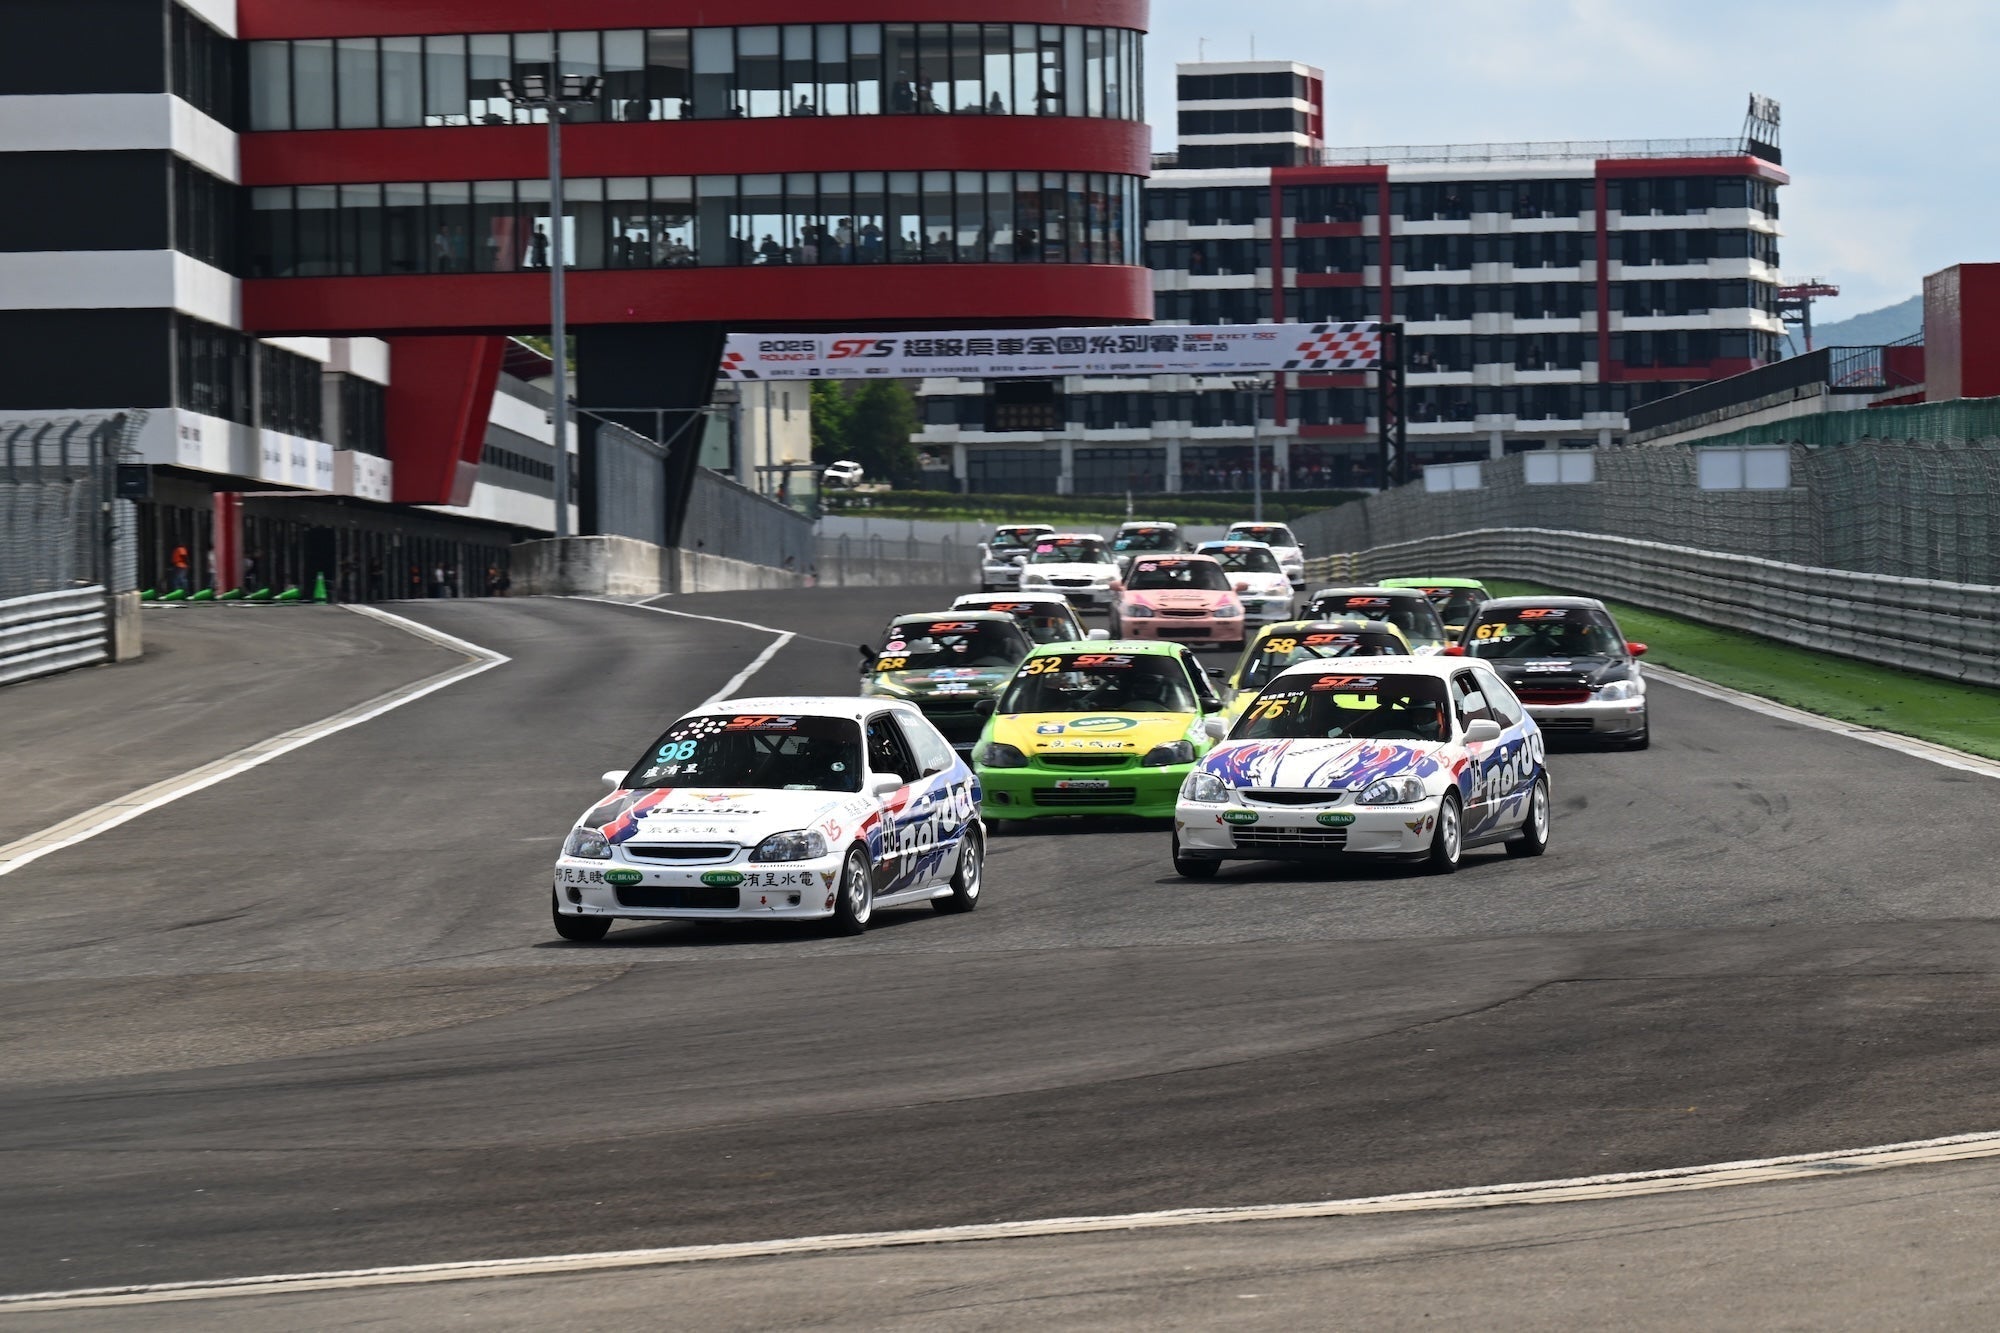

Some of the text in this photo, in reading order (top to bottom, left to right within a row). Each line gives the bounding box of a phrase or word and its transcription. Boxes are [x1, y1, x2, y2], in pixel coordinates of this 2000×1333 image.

[759, 340, 815, 351] 2025
[826, 339, 898, 359] STS
[1518, 609, 1570, 619] STS
[929, 622, 979, 632] STS
[1476, 623, 1508, 639] 67
[1263, 638, 1298, 654] 58
[1304, 634, 1360, 645] STS
[1027, 657, 1062, 674] 52
[1072, 654, 1134, 665] STS
[1312, 676, 1383, 687] STS
[1248, 700, 1289, 719] 75
[727, 716, 802, 727] STS
[656, 740, 698, 763] 98
[883, 817, 895, 853] 98
[743, 871, 814, 887] 洧呈水電
